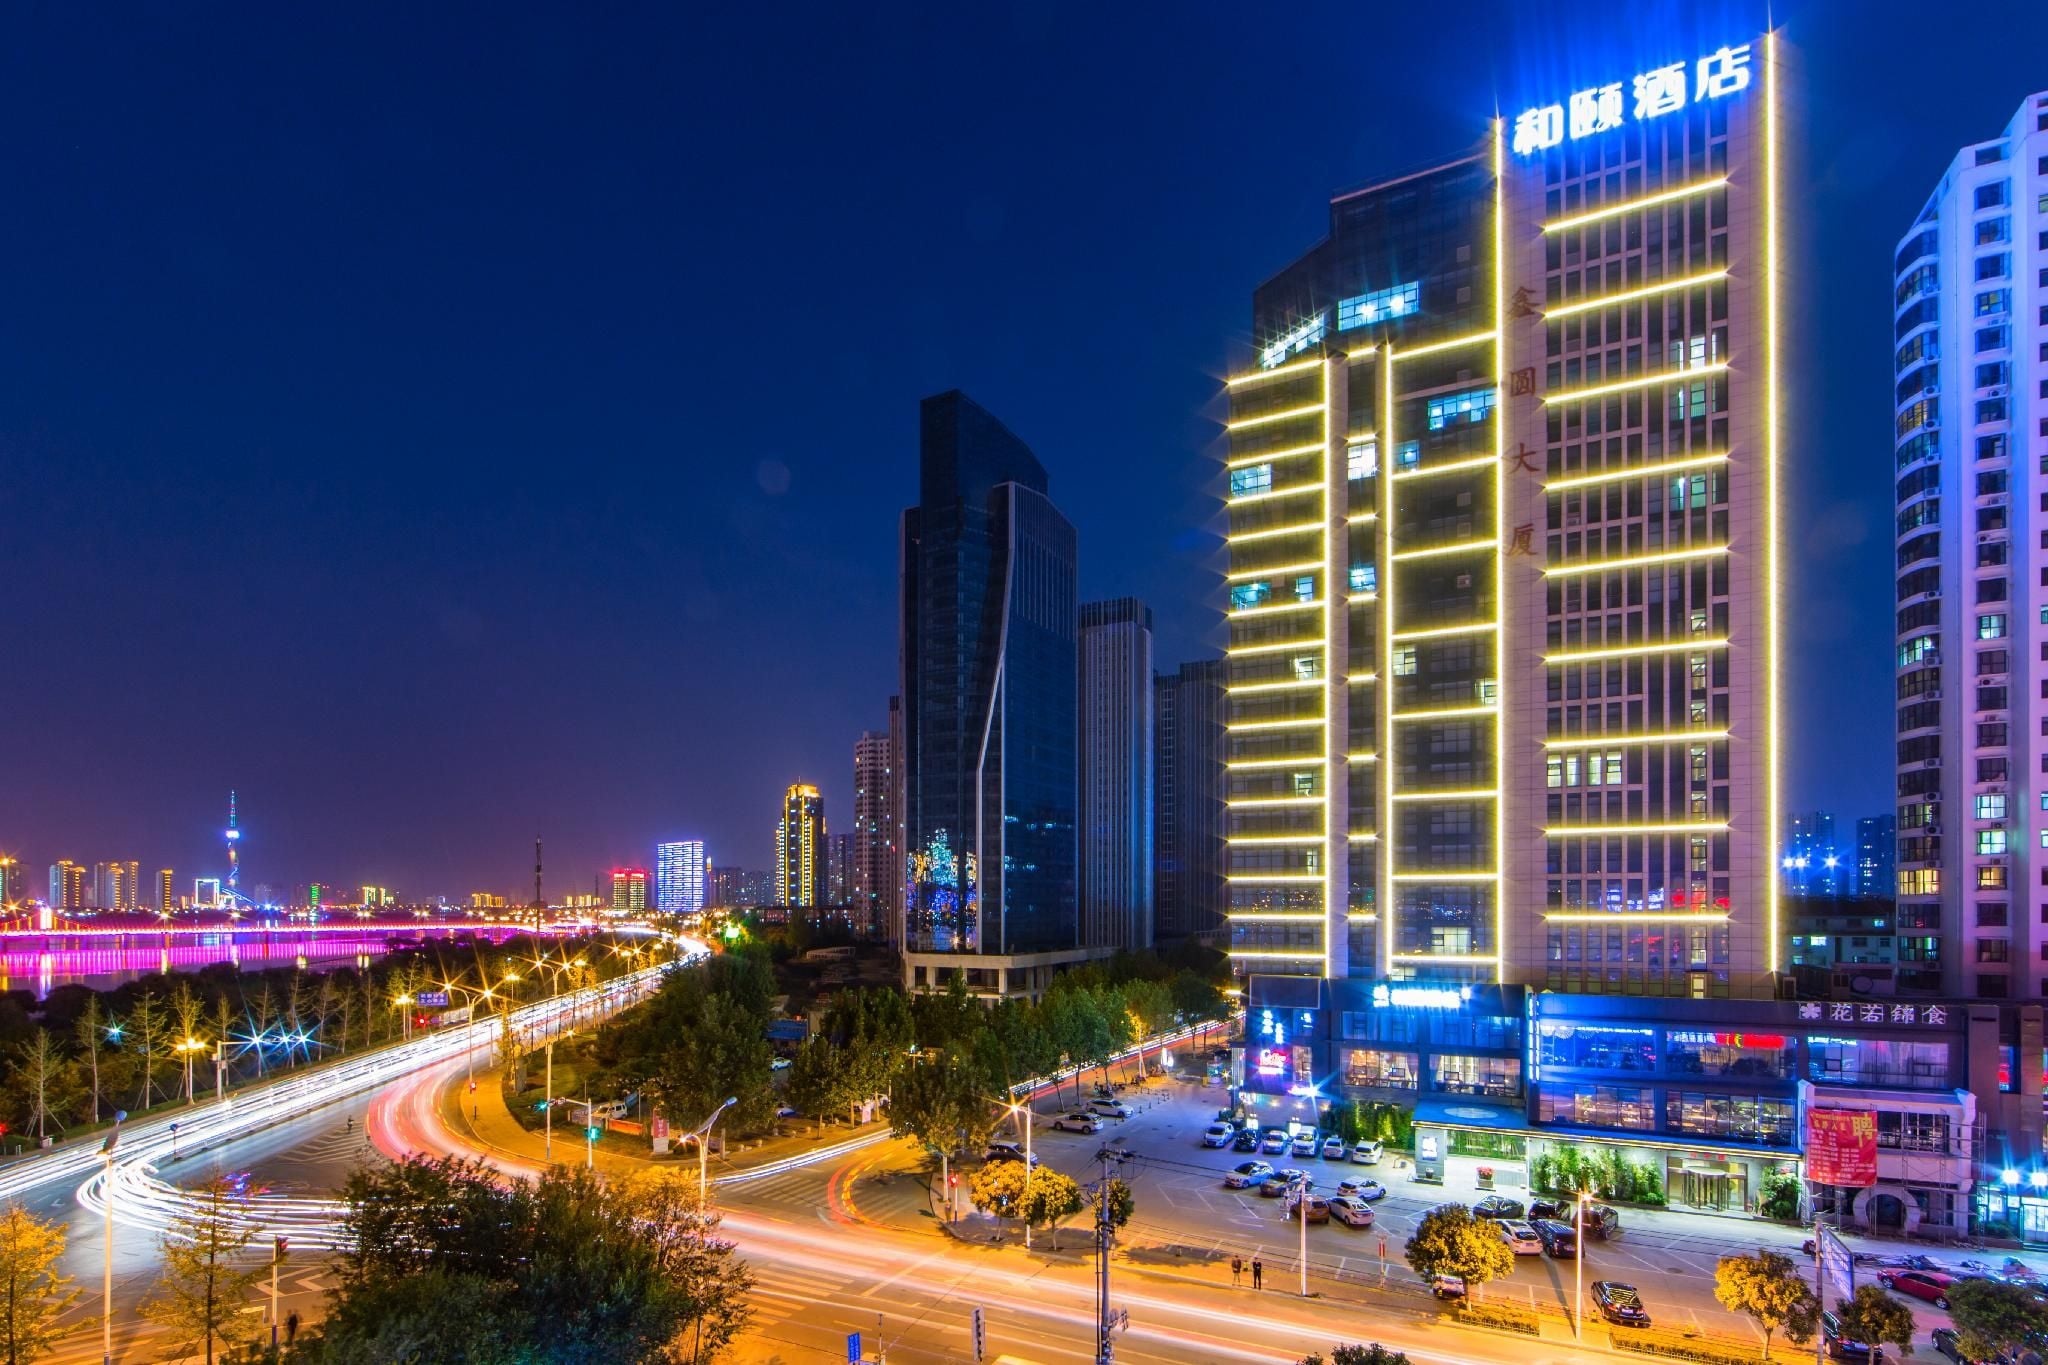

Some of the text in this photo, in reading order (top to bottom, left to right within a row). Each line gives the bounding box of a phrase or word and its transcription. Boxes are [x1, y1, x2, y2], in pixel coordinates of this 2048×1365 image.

[1513, 44, 1751, 155] 和颐酒店
[1851, 1112, 1877, 1147] 聘
